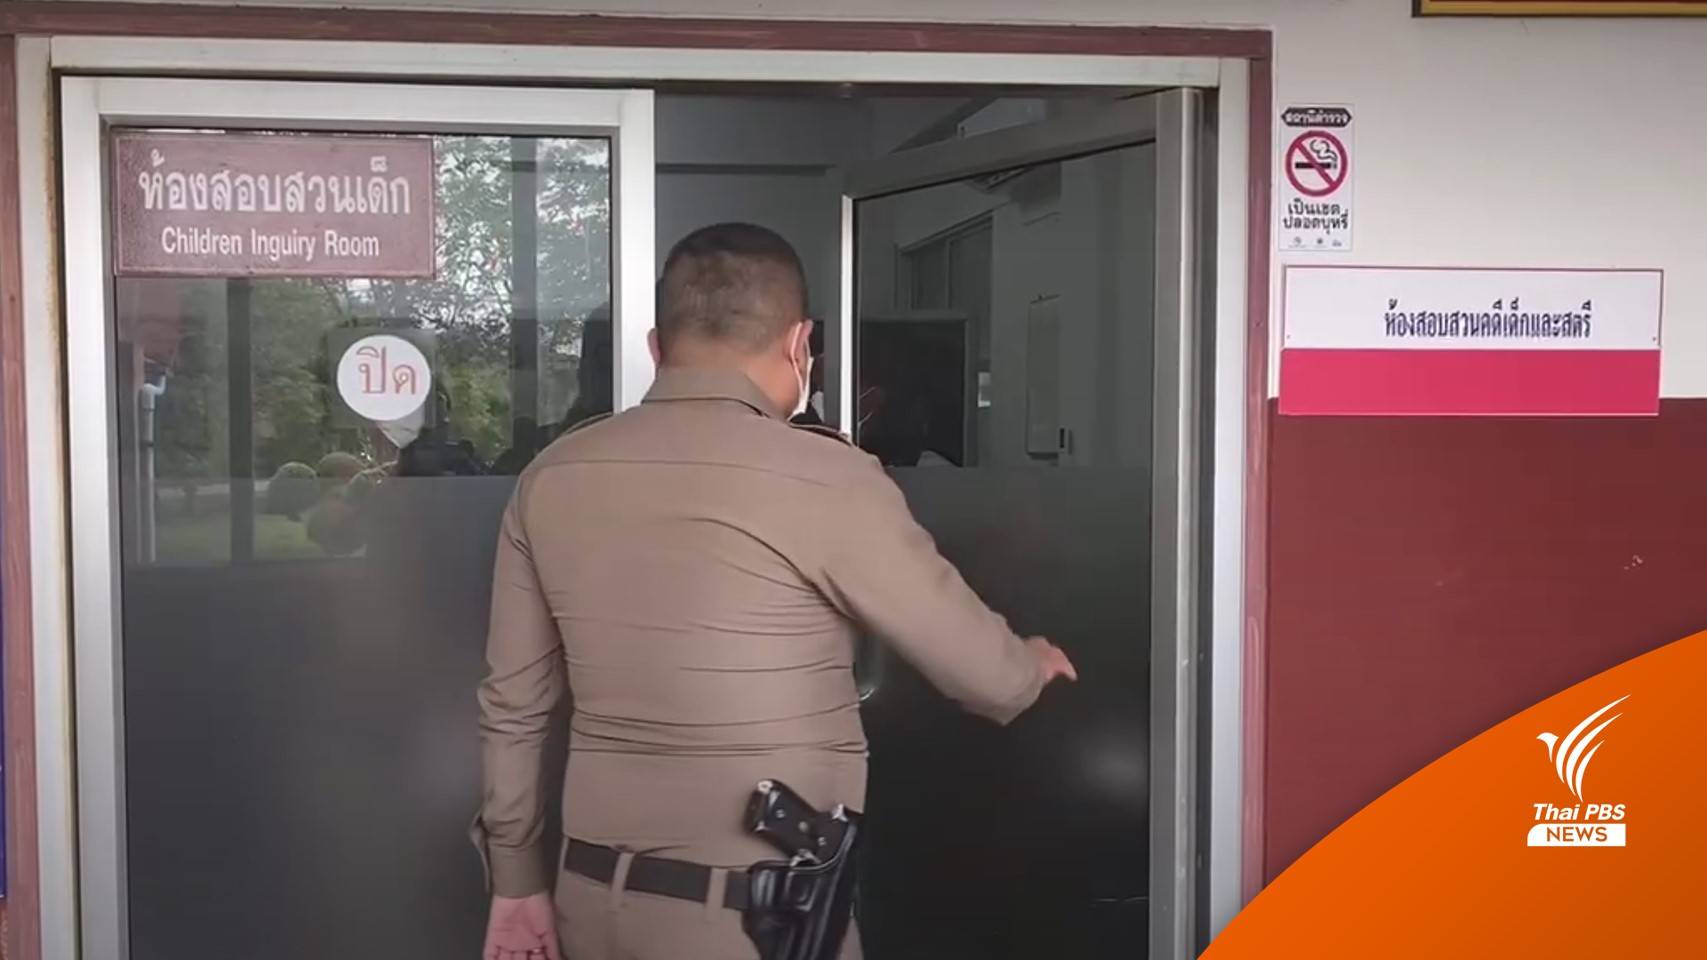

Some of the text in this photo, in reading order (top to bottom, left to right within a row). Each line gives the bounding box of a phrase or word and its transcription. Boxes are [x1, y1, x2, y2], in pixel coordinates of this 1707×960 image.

[138, 149, 411, 214] ห้องสอบสวนเด็ก
[1283, 209, 1348, 235] ปลอดบุหรี่
[1288, 198, 1341, 215] เป็นเขต
[161, 227, 242, 255] Children
[324, 231, 380, 256] Room
[1384, 297, 1593, 339] ห้องสอบสวนคดีเด็กและสตรี
[356, 346, 417, 395] ปิด
